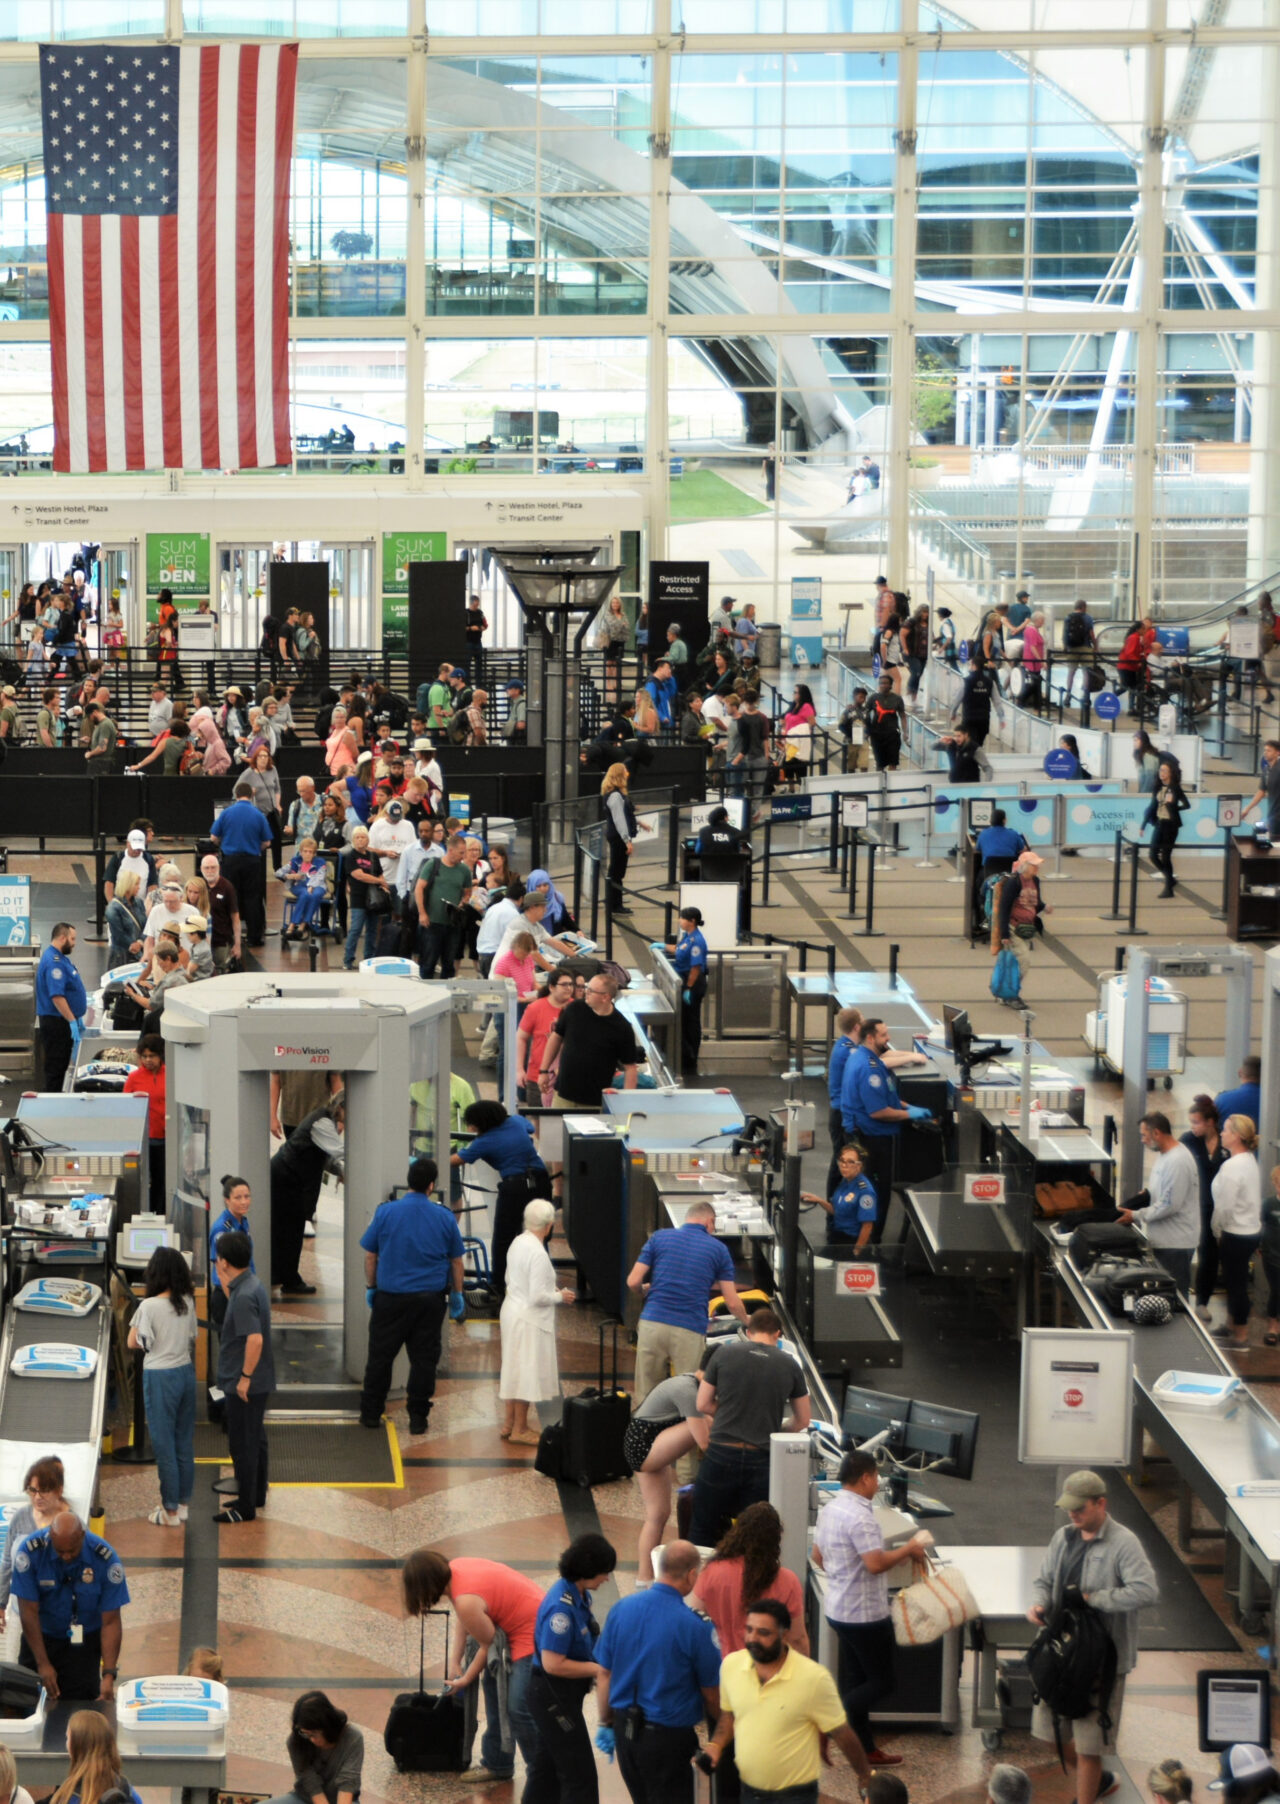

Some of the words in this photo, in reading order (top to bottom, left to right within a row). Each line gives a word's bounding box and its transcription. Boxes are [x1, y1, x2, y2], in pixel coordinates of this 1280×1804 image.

[160, 540, 196, 554] SUM
[396, 538, 432, 552] SUM
[160, 555, 196, 569] MER
[160, 570, 196, 582] DEN
[660, 575, 700, 584] Restricted
[666, 585, 694, 593] Access
[1090, 810, 1123, 819] Access
[1125, 809, 1134, 819] in
[1103, 822, 1128, 831] blink
[712, 833, 729, 842] TSA
[14, 896, 24, 905] IT
[287, 1047, 329, 1055] ProVision
[792, 1108, 797, 1120] 7
[976, 1184, 997, 1192] STOP
[848, 1274, 872, 1282] STOP
